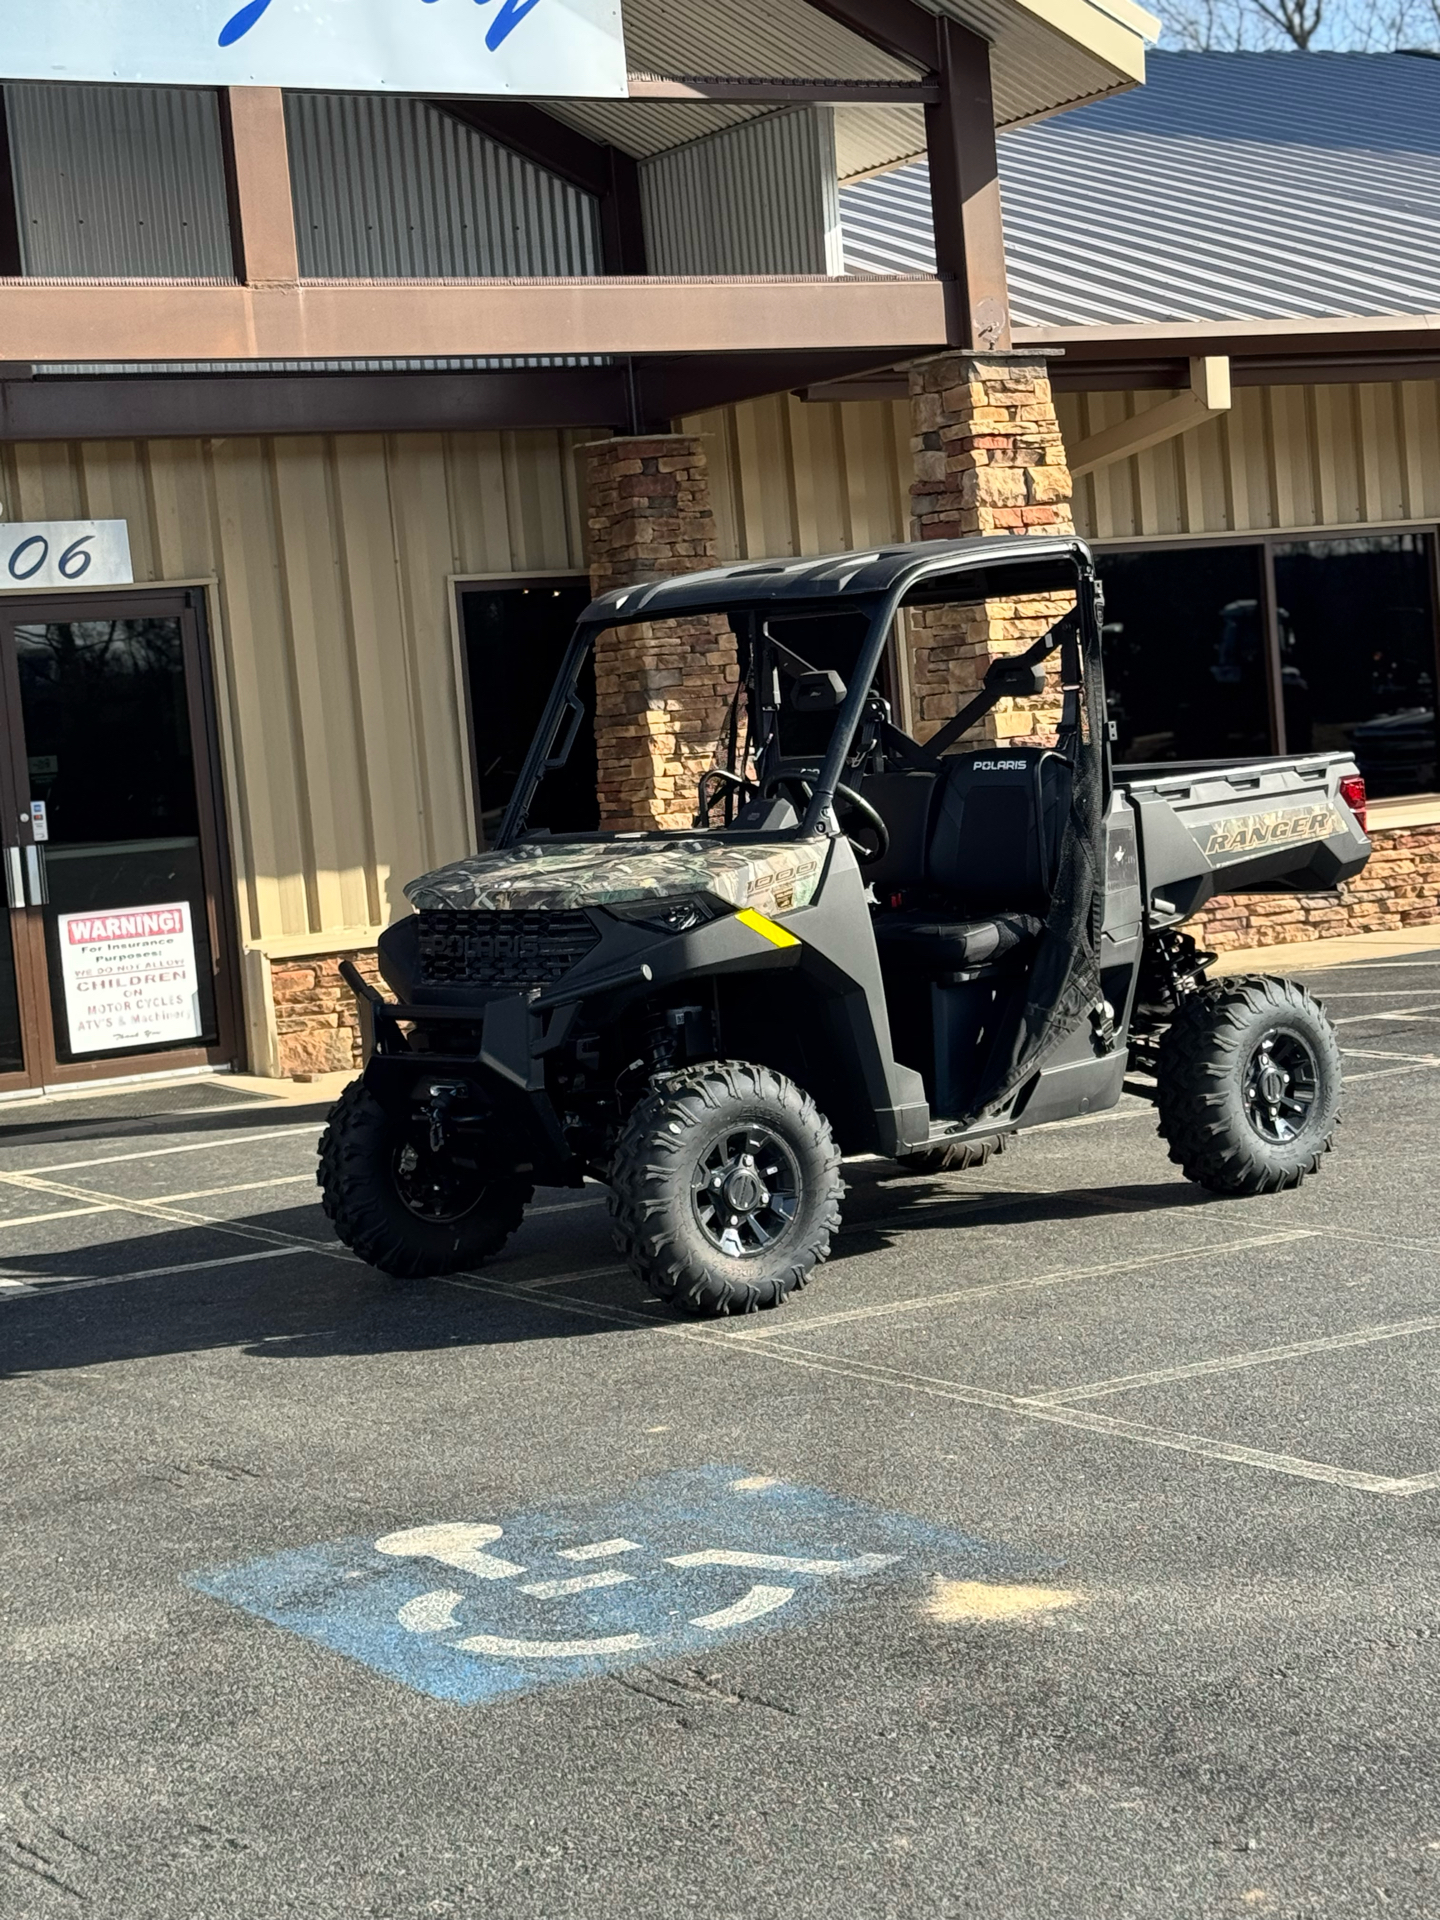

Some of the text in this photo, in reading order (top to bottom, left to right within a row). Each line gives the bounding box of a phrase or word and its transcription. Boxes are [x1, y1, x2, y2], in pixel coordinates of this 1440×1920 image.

[973, 760, 1028, 771] POLARIS
[1205, 812, 1330, 855] RANGER
[747, 861, 818, 893] 1000
[70, 911, 181, 939] WARNING!
[81, 938, 174, 954] For Insurance
[96, 950, 162, 963] Purposes:
[431, 935, 540, 958] POLARIS
[75, 959, 185, 977] WE DO NOT ALLOW
[77, 970, 186, 992] CHILDREN
[123, 988, 143, 999] ON
[87, 995, 184, 1016] MOTOR CYCLES
